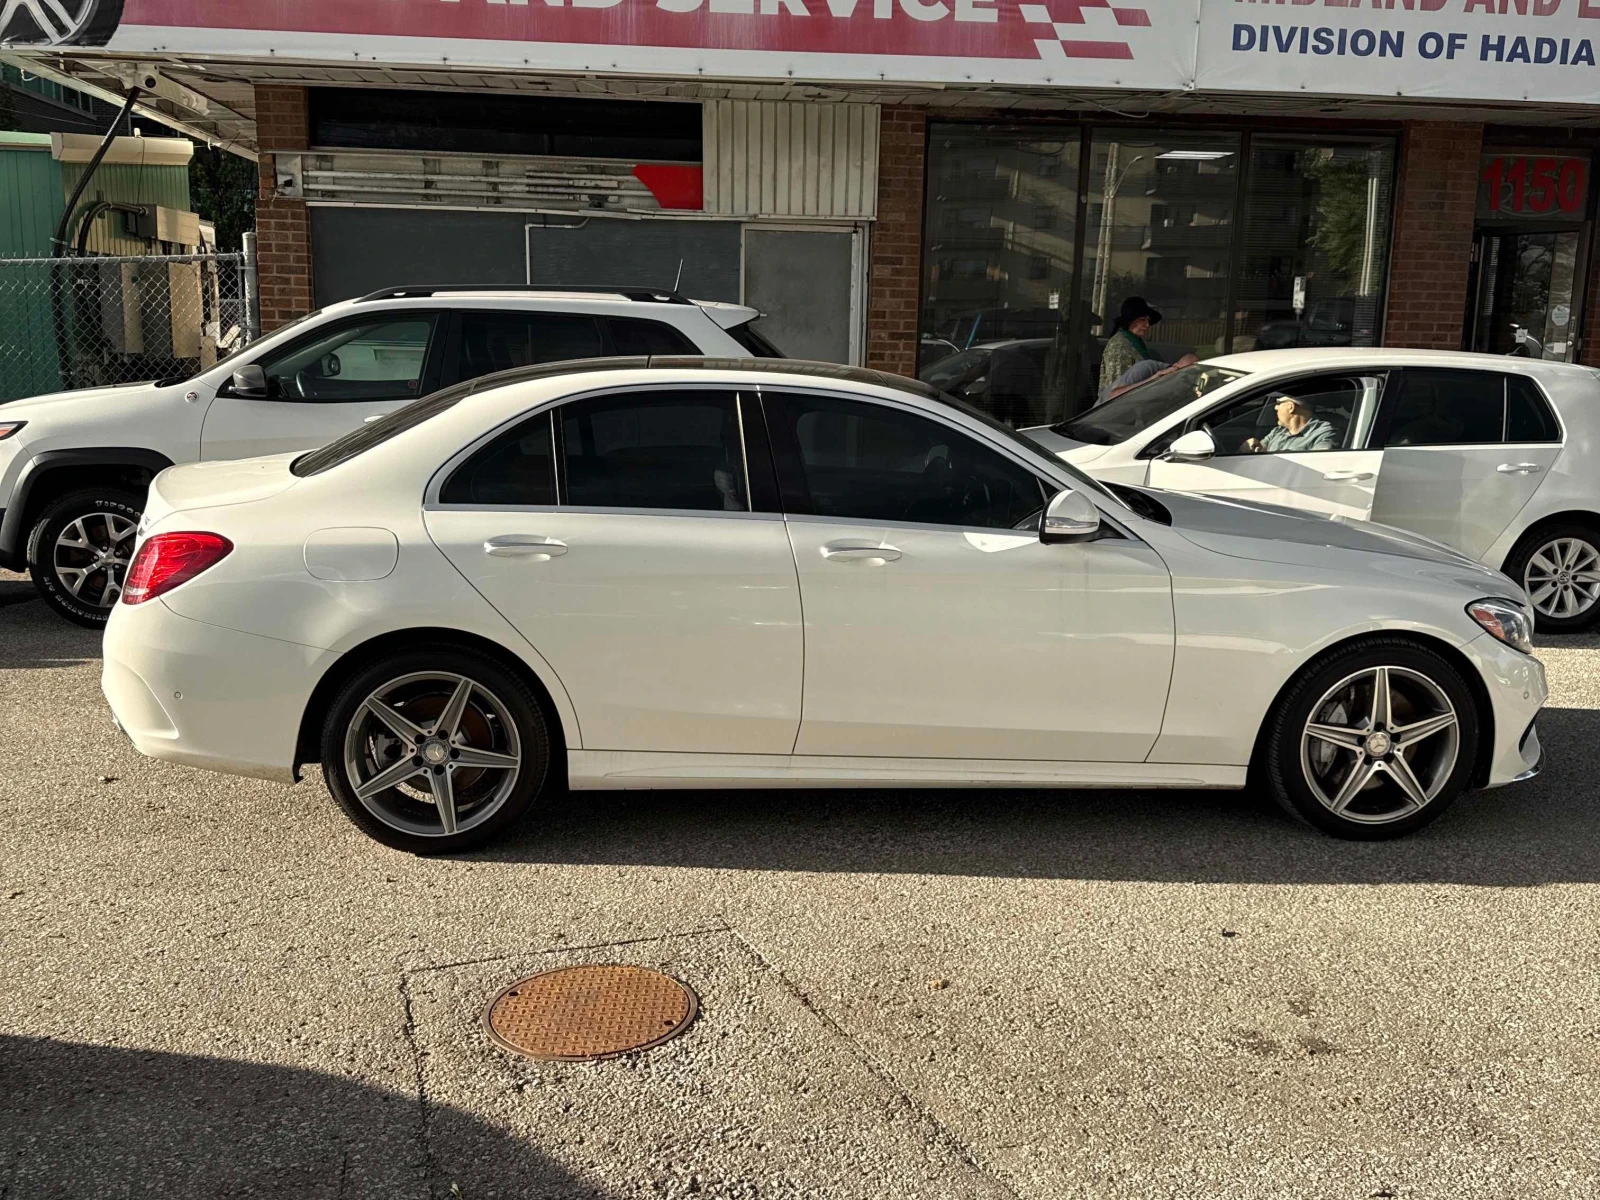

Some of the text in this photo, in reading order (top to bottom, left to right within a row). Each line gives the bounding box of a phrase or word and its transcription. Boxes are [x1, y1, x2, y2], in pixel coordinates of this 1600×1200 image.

[1232, 24, 1596, 66] DIVISION OF HADIA
[1482, 156, 1586, 212] 1150
